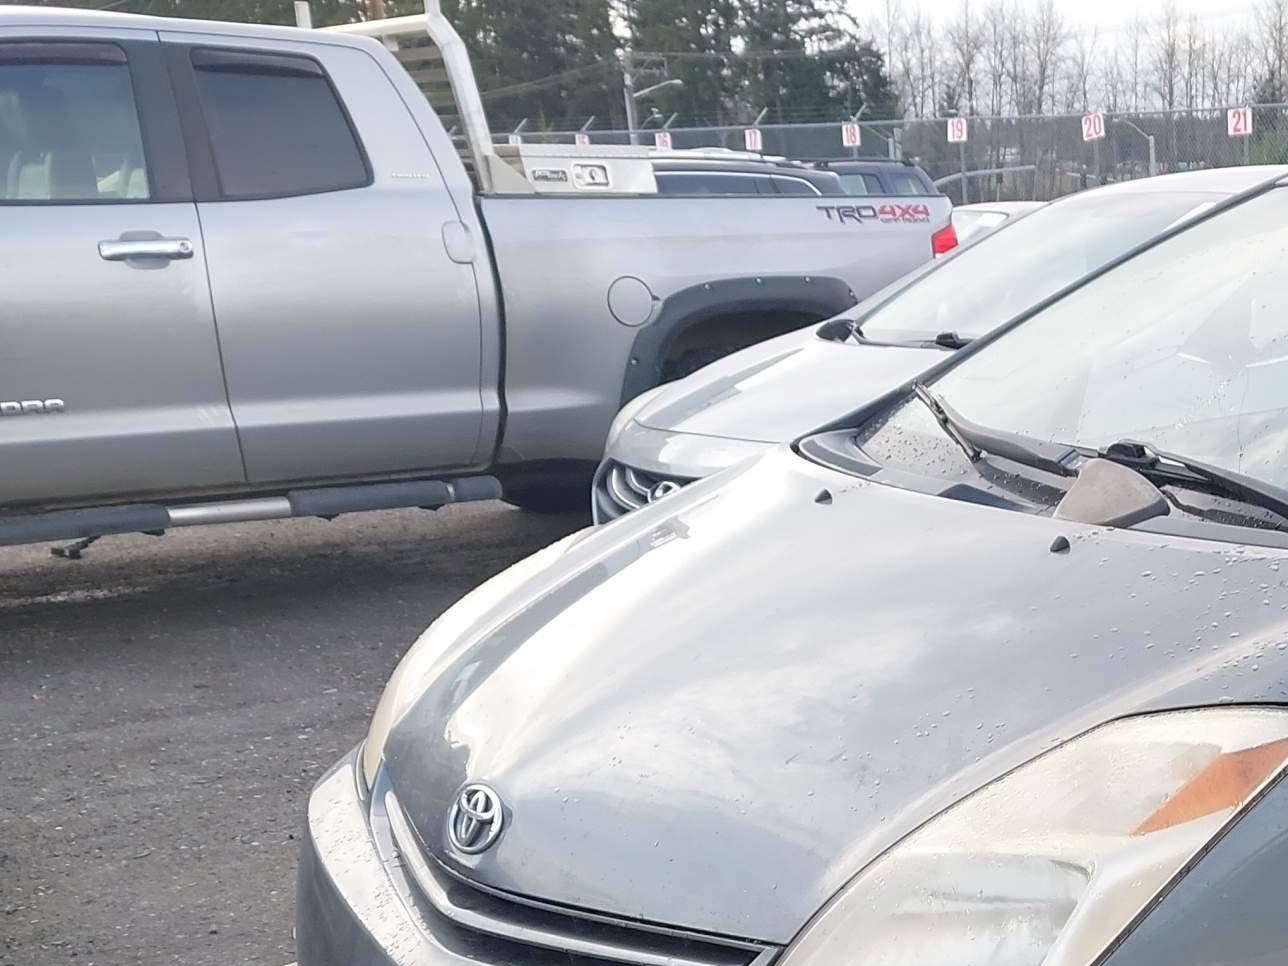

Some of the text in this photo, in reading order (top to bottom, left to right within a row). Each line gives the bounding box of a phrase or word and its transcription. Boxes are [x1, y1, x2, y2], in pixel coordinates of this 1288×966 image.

[951, 120, 963, 140] 19
[1084, 115, 1102, 138] 20
[1231, 110, 1249, 133] 21
[845, 125, 857, 144] 18
[816, 205, 877, 224] TRD
